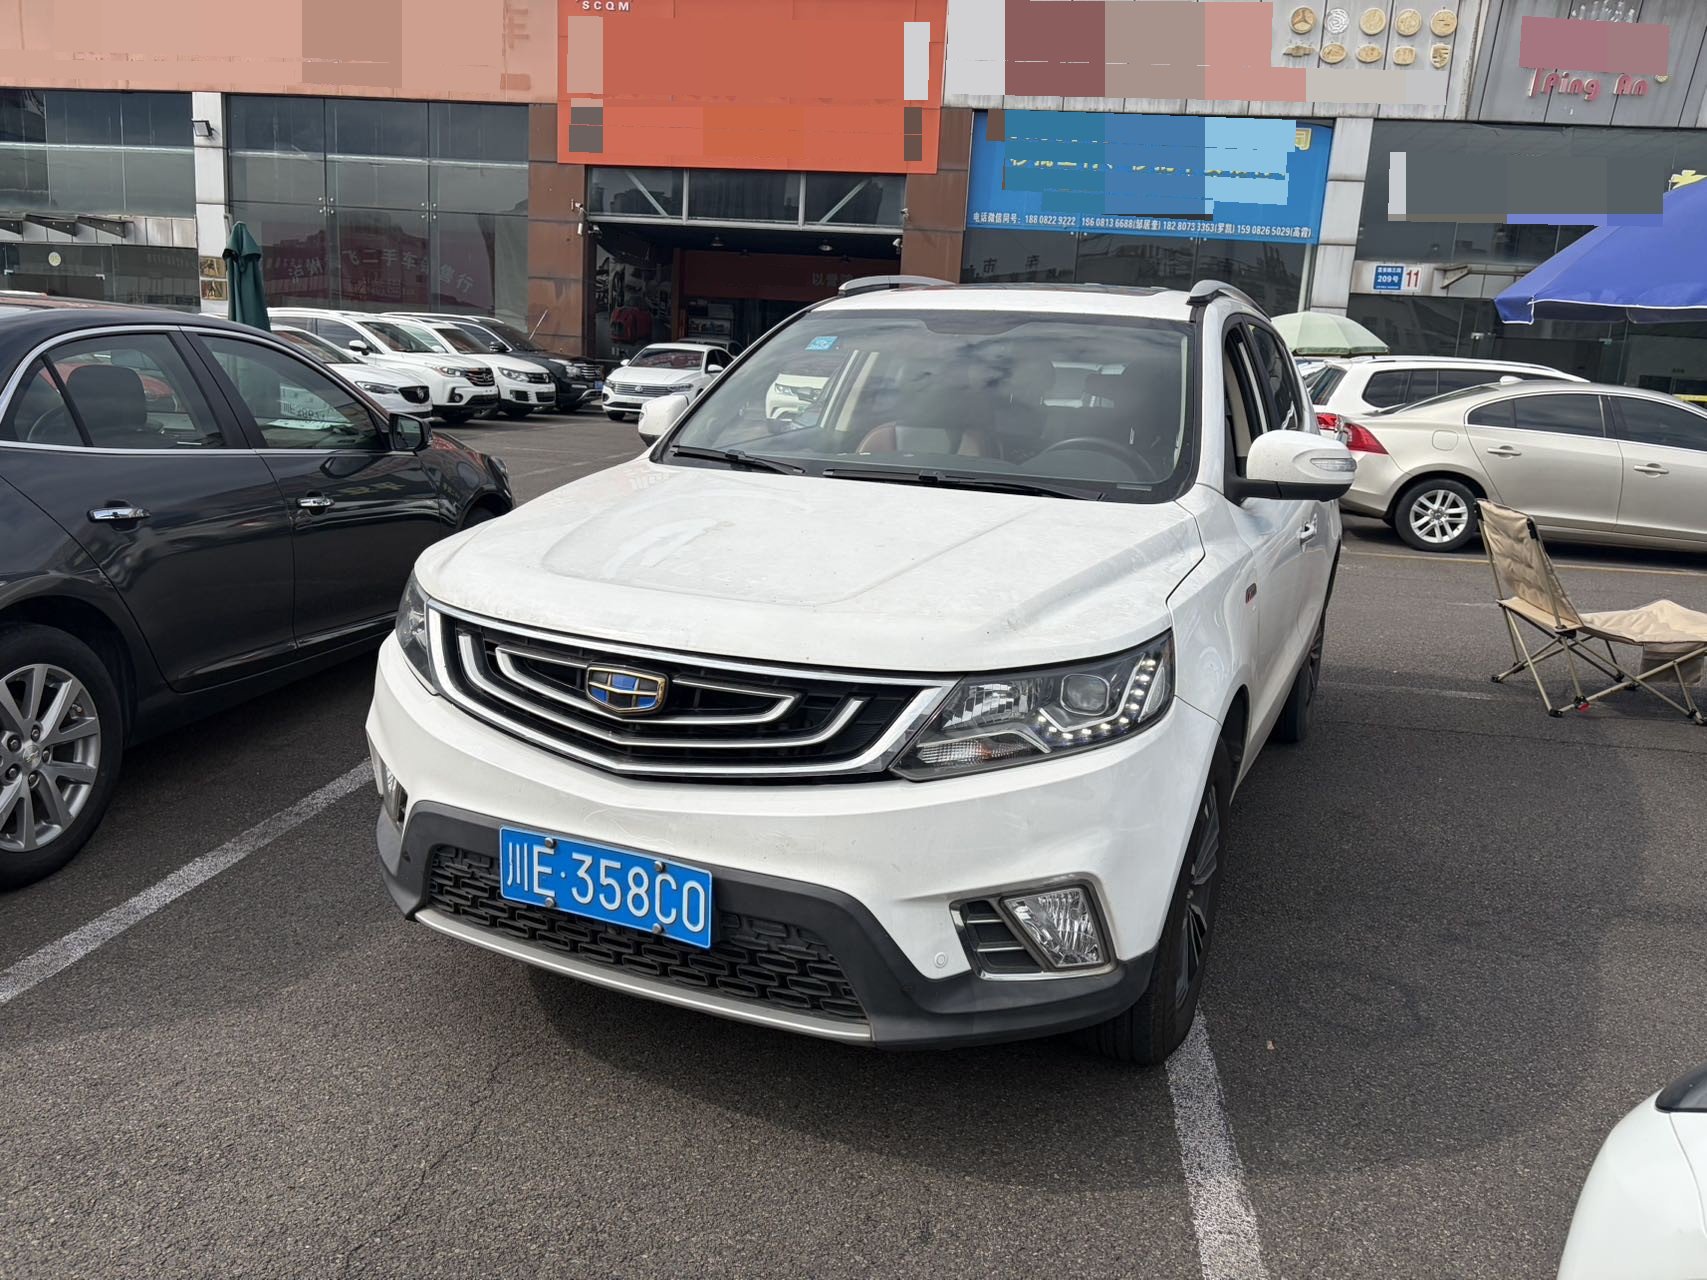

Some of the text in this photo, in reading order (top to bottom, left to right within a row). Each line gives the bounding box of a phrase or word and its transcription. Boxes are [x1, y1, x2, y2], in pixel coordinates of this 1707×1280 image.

[582, 1, 630, 11] SCQM
[1541, 71, 1649, 101] Ping An
[1025, 215, 1038, 224] 188
[1039, 215, 1057, 225] 0822
[1057, 216, 1076, 226] 9222
[1096, 218, 1114, 228] 0813
[1163, 221, 1176, 230] 182
[1177, 221, 1196, 231] 8073
[1237, 224, 1251, 234] 159
[1251, 225, 1270, 235] 0826
[1377, 275, 1399, 283] 209号
[1406, 269, 1420, 288] 11
[506, 842, 706, 934] 川E·358C0
